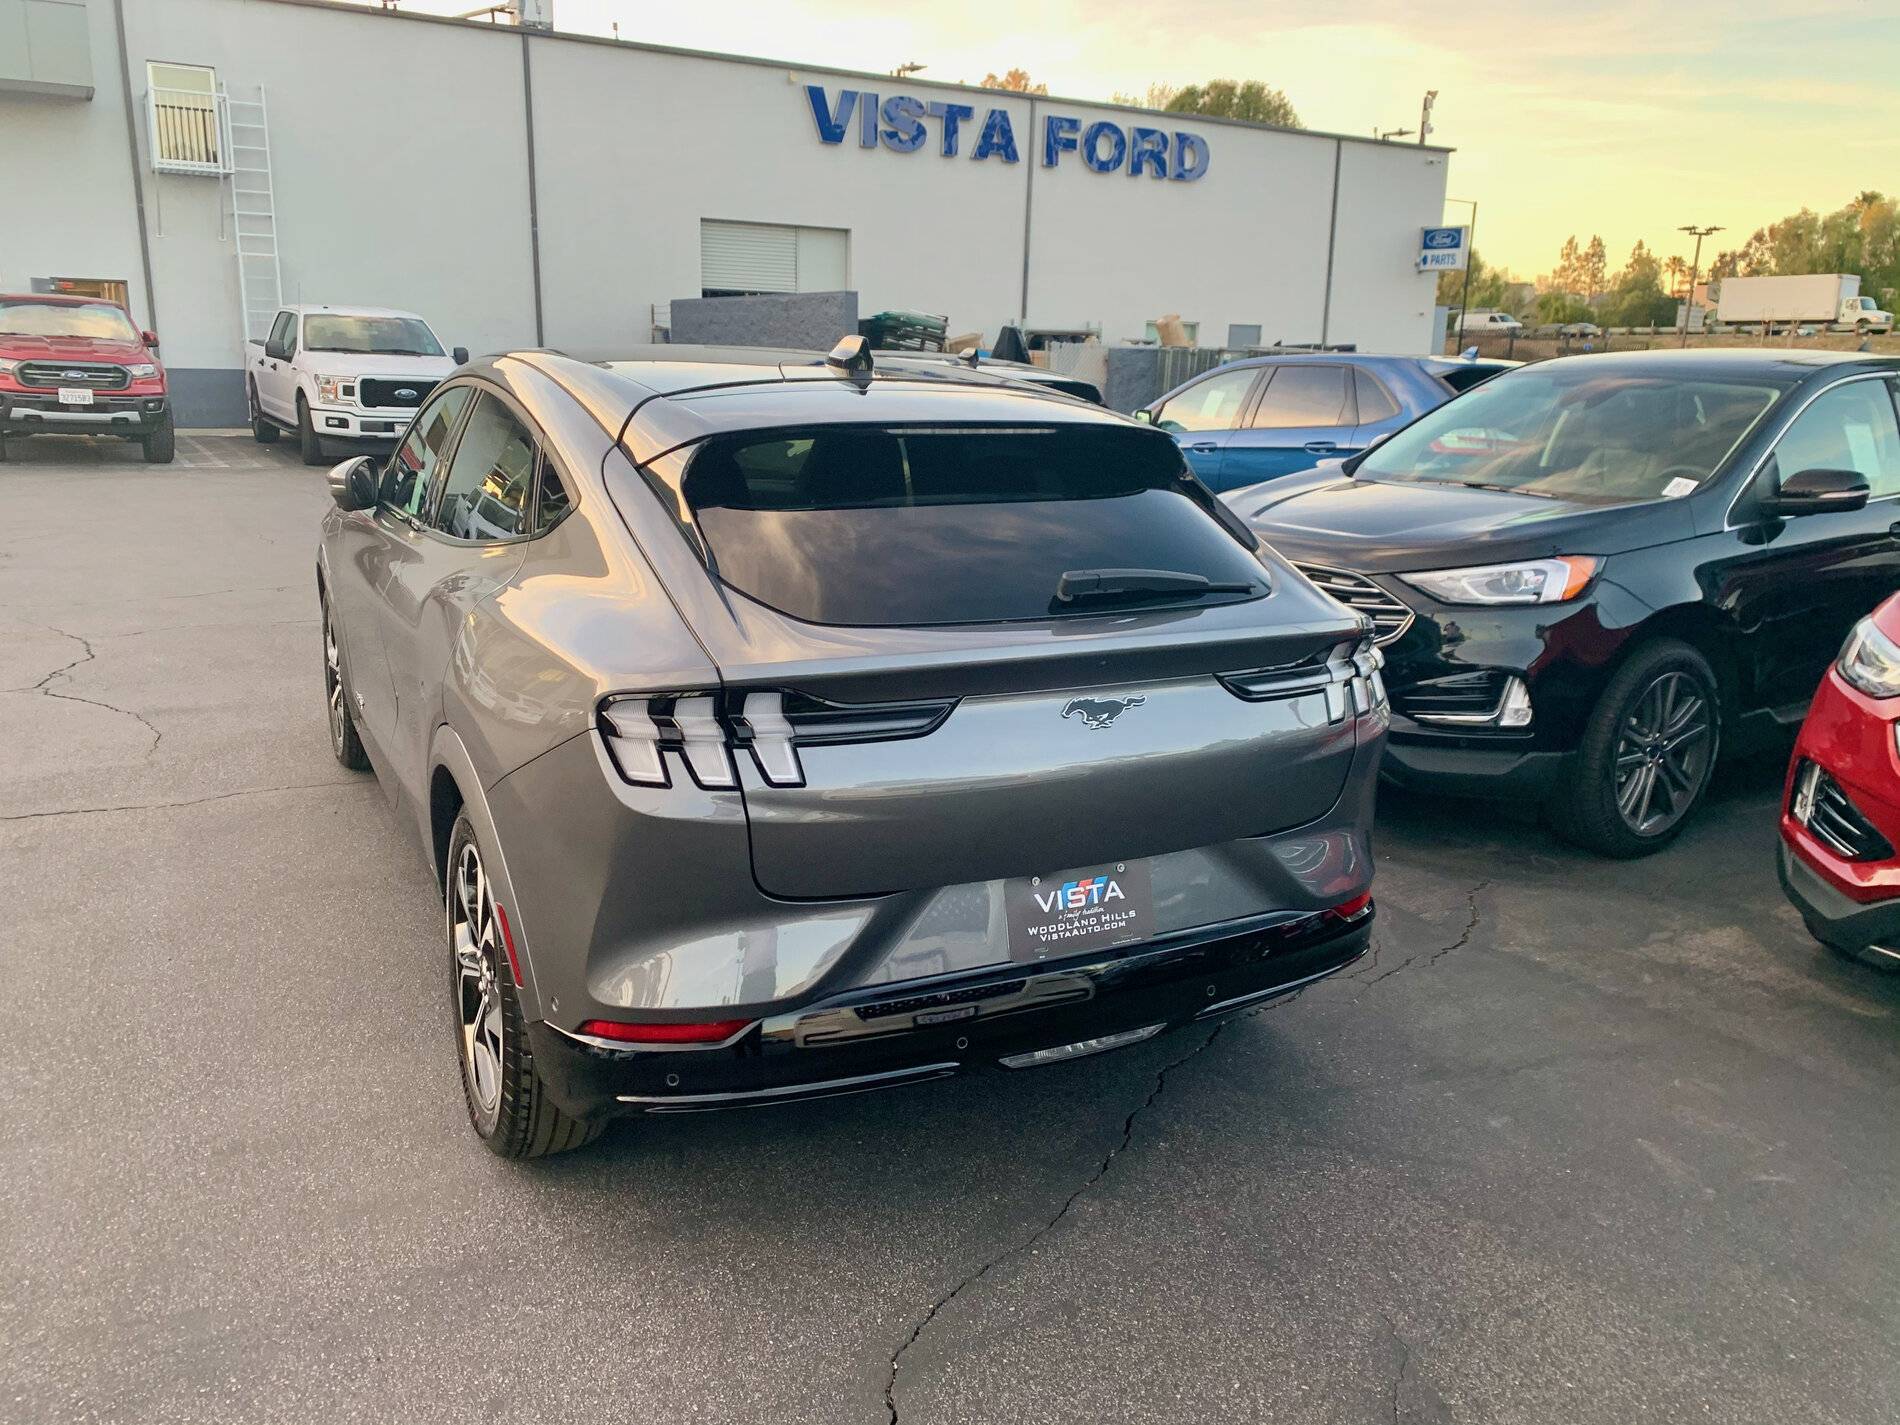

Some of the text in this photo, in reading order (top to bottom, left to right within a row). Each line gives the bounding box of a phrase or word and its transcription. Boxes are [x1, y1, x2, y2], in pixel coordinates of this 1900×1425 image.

[804, 85, 1211, 183] VISTA FORD
[1431, 254, 1457, 266] PARTS
[1033, 880, 1126, 913] VISTA
